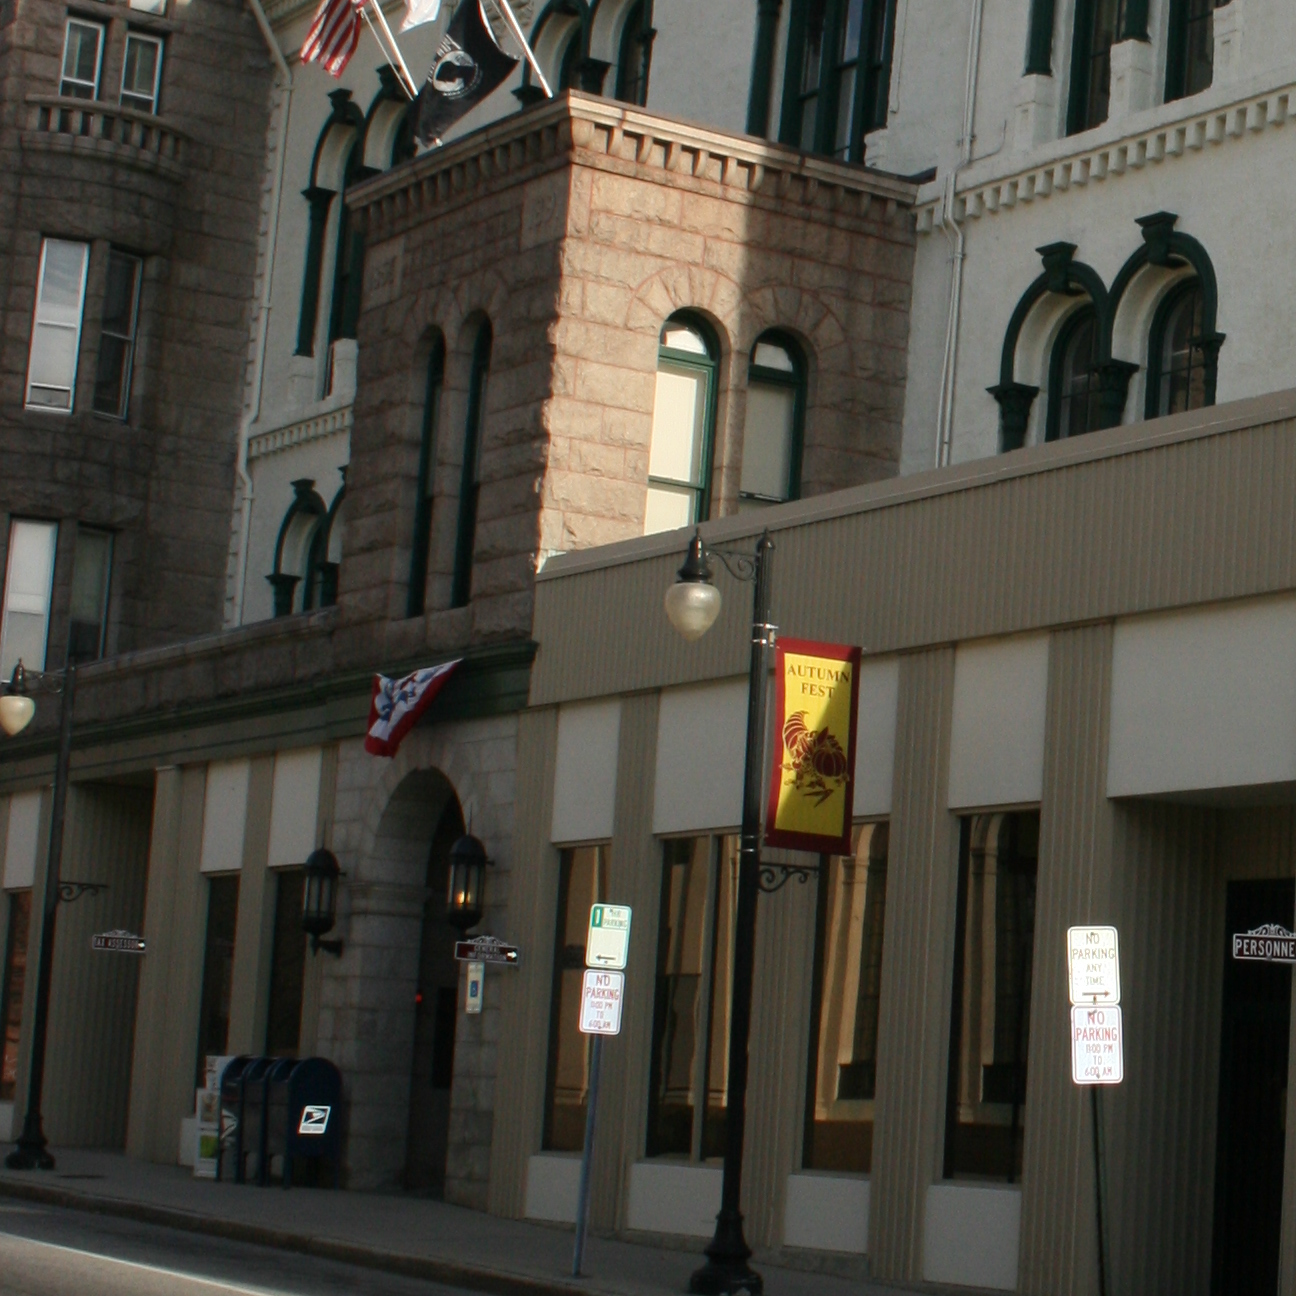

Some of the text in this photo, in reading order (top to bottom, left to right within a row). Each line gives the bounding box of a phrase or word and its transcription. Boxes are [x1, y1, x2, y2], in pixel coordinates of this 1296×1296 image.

[787, 664, 850, 683] AUTUMN
[801, 682, 835, 698] FEST
[603, 918, 628, 928] PARKING
[1086, 933, 1100, 945] NO
[1072, 948, 1116, 960] PARKING
[1086, 963, 1102, 972] ANY
[596, 975, 610, 986] NO
[1085, 976, 1104, 986] TIME
[585, 987, 619, 1000] PARKING
[604, 1001, 613, 1009] PM
[596, 1011, 604, 1019] TO
[1088, 1010, 1105, 1025] NO
[603, 1020, 611, 1029] AM
[1075, 1027, 1118, 1041] PARKING
[1103, 1044, 1113, 1053] PM
[1093, 1055, 1103, 1065] TO
[1102, 1066, 1112, 1076] AM
